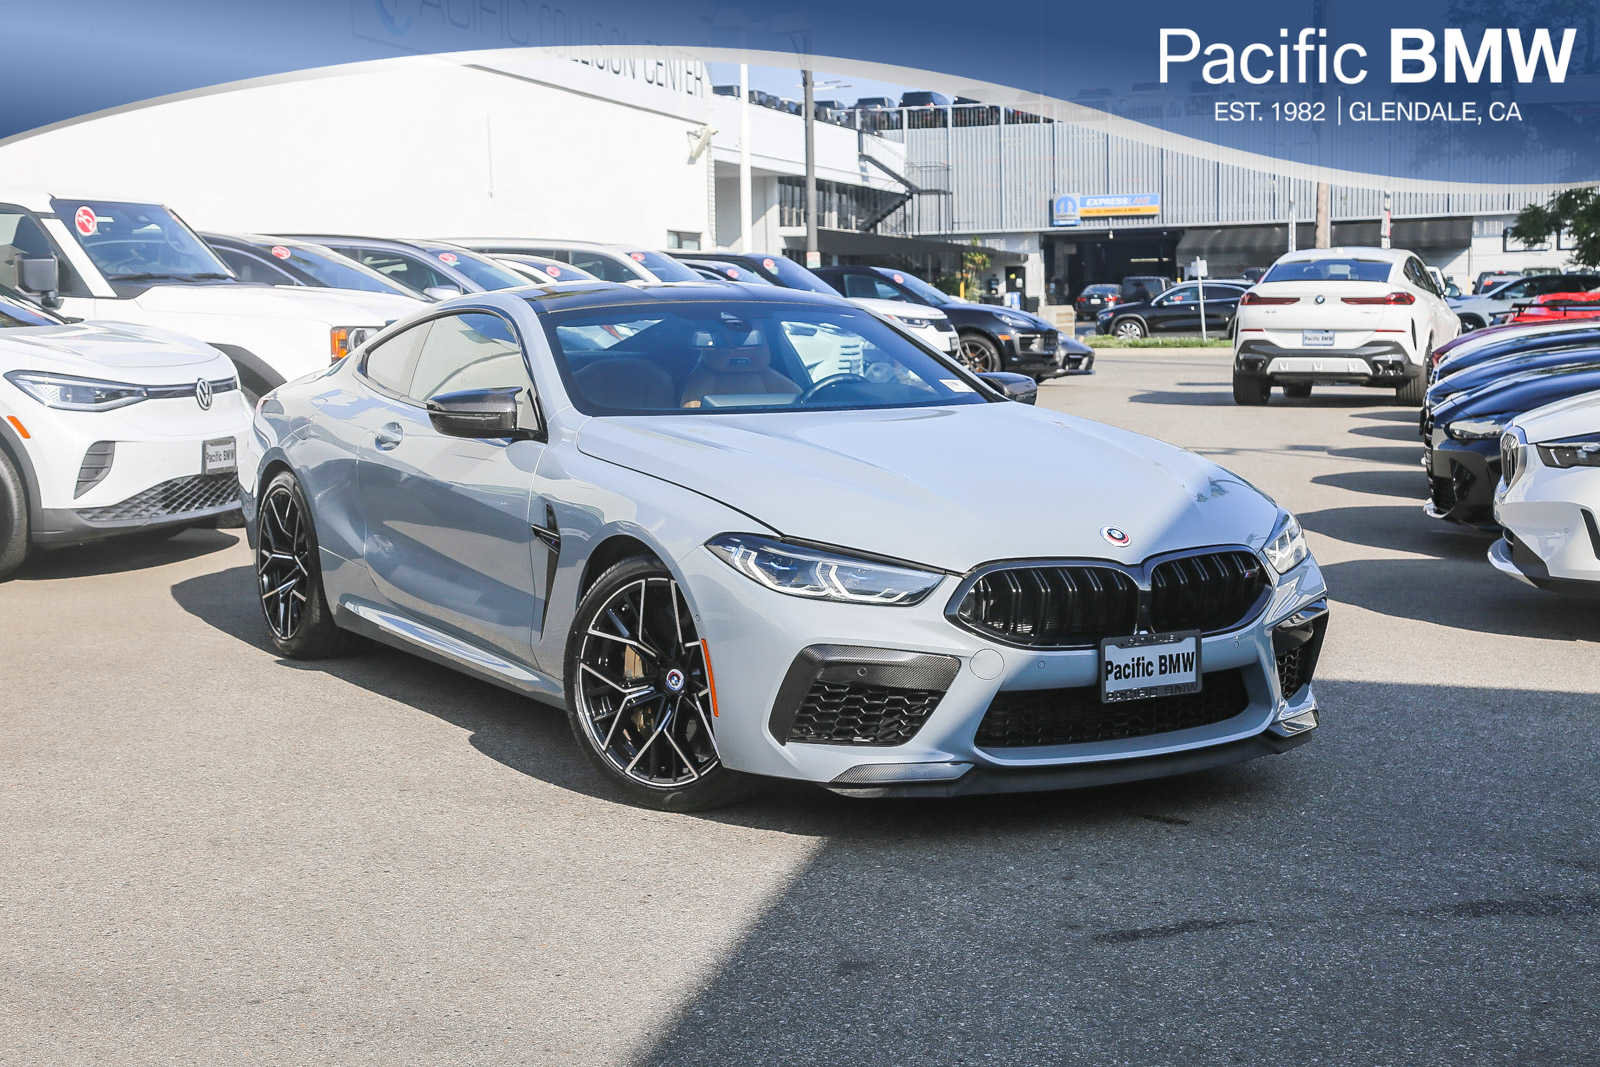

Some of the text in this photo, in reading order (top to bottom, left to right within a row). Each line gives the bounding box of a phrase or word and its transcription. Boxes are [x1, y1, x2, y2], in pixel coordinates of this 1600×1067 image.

[644, 43, 705, 98] CENTER
[1105, 651, 1195, 681] Pacific BMW
